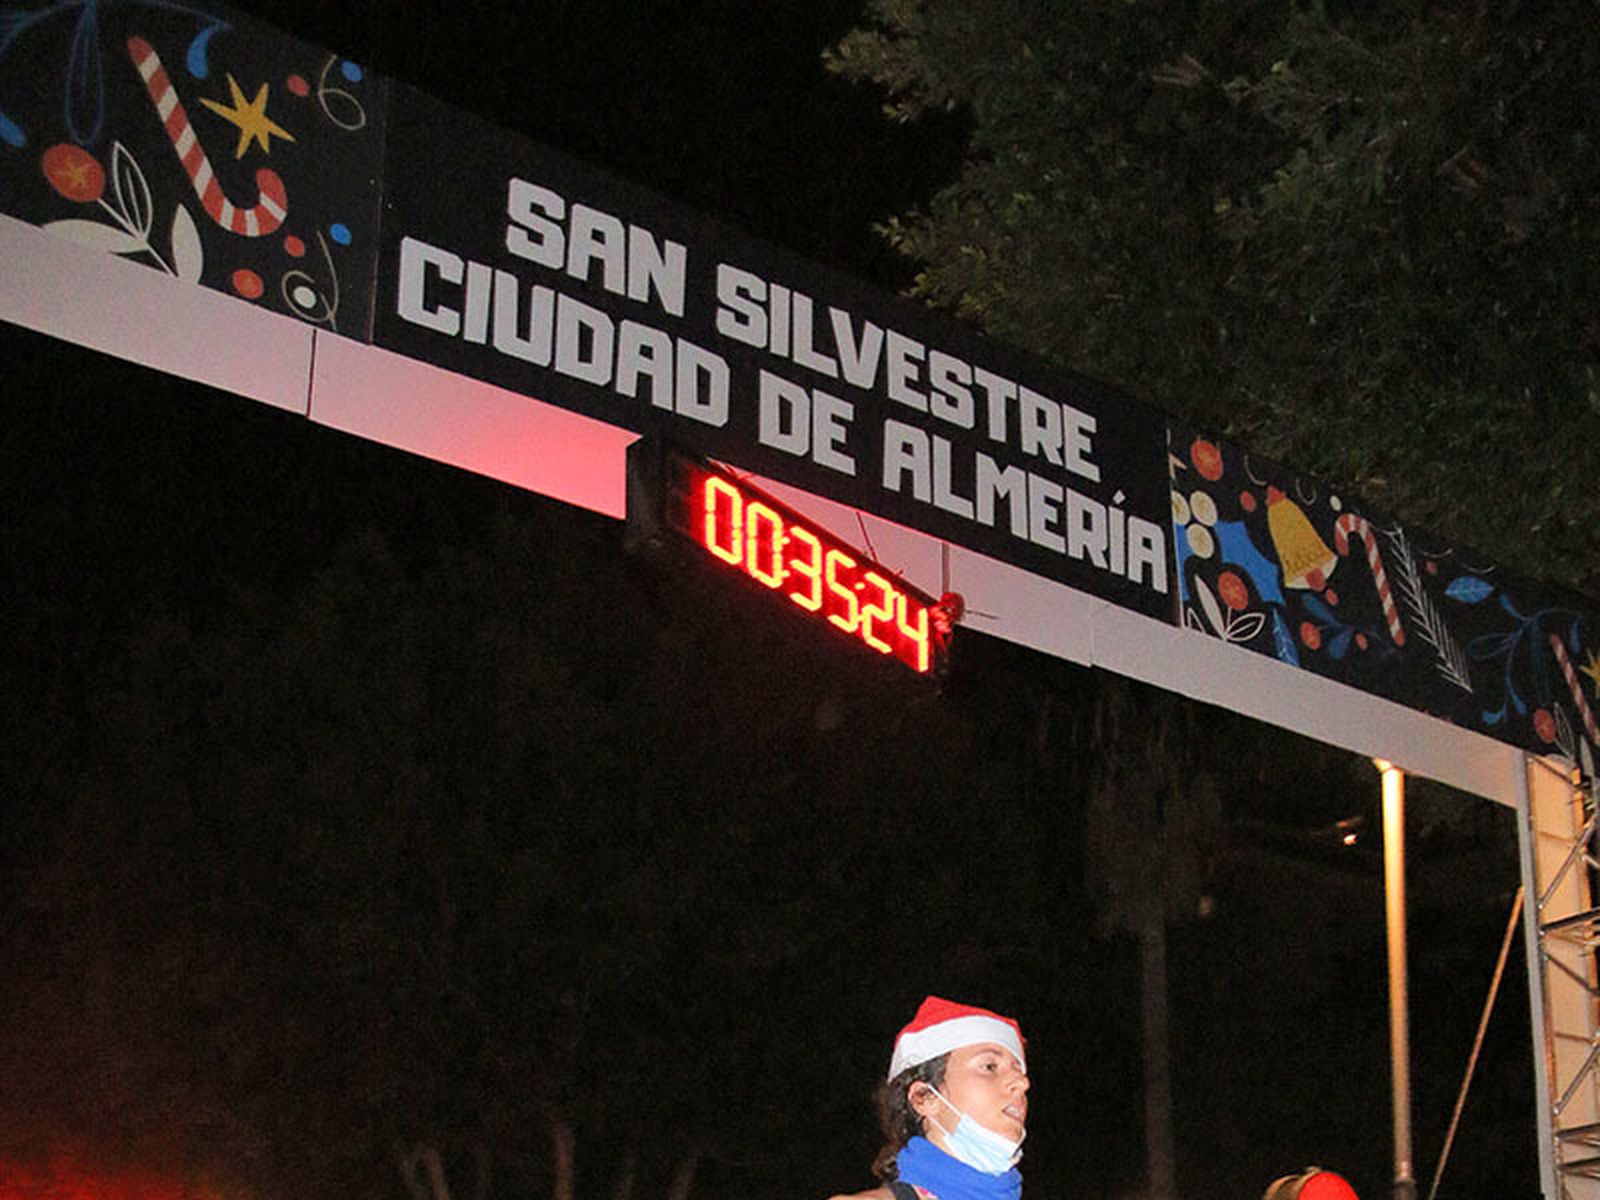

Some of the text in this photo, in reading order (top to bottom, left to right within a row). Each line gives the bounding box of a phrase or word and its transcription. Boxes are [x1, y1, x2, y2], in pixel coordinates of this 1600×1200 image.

[397, 235, 1168, 594] CIUDAD DE ALMERÍA
[505, 177, 1101, 482] SAN SILVESTRE
